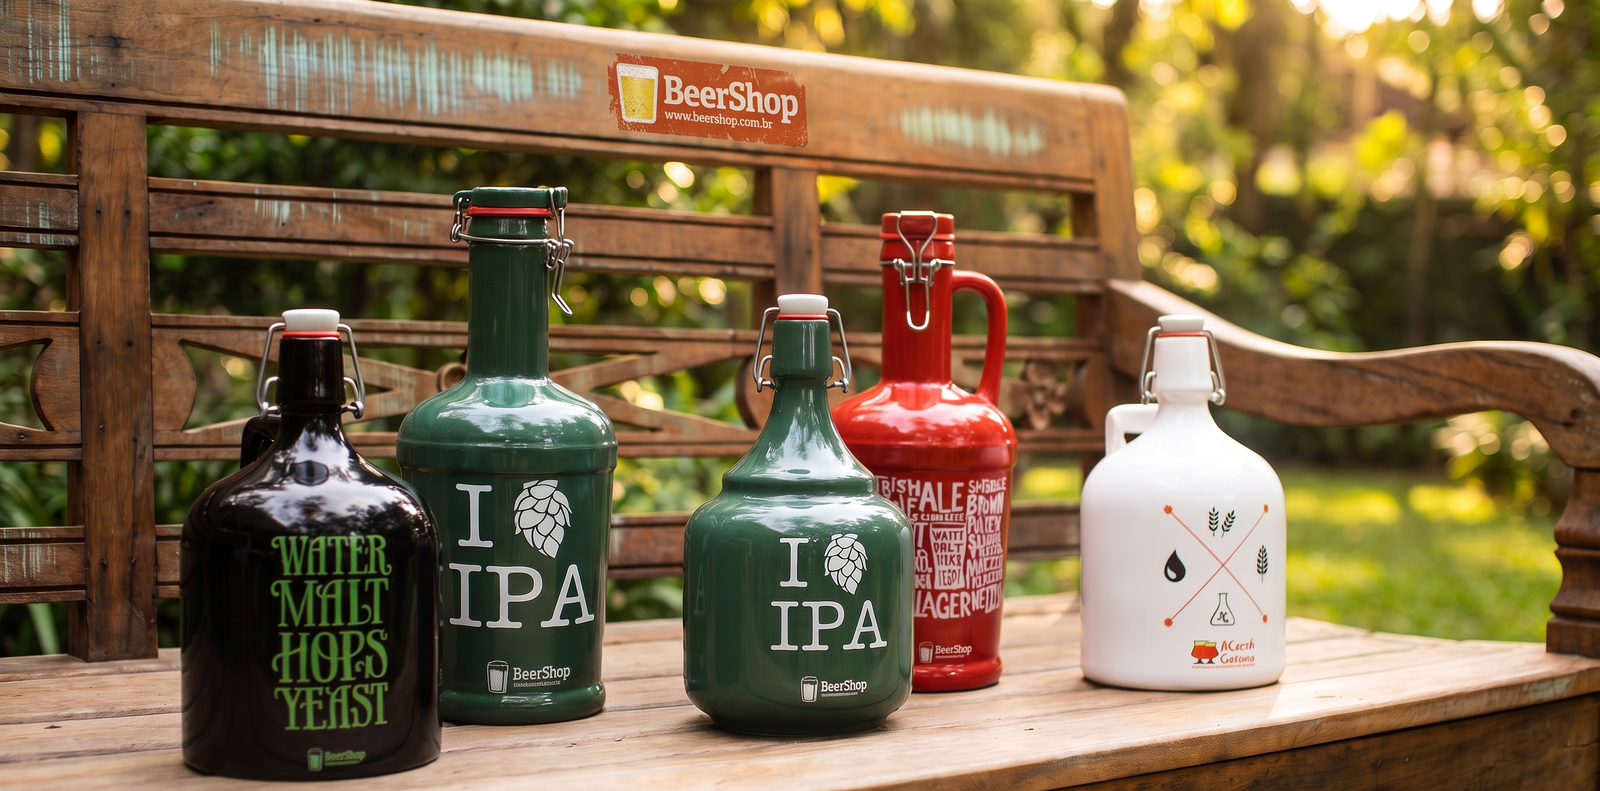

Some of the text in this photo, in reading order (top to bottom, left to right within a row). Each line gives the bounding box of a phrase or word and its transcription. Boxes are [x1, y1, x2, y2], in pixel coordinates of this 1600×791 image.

[663, 75, 799, 124] BeerShop
[664, 111, 773, 129] www.beershop.com.br
[456, 483, 494, 548] I
[271, 535, 392, 576] WATER
[779, 537, 809, 587] I
[270, 578, 389, 627] MALT
[448, 563, 594, 629] IPA
[770, 599, 888, 651] IPA
[271, 629, 388, 683] HOPS
[513, 665, 571, 681] BeerShop
[935, 645, 972, 655] BeerShop
[274, 682, 388, 730] YEAST
[821, 679, 868, 693] BeerShop
[325, 750, 366, 761] BeerShop
